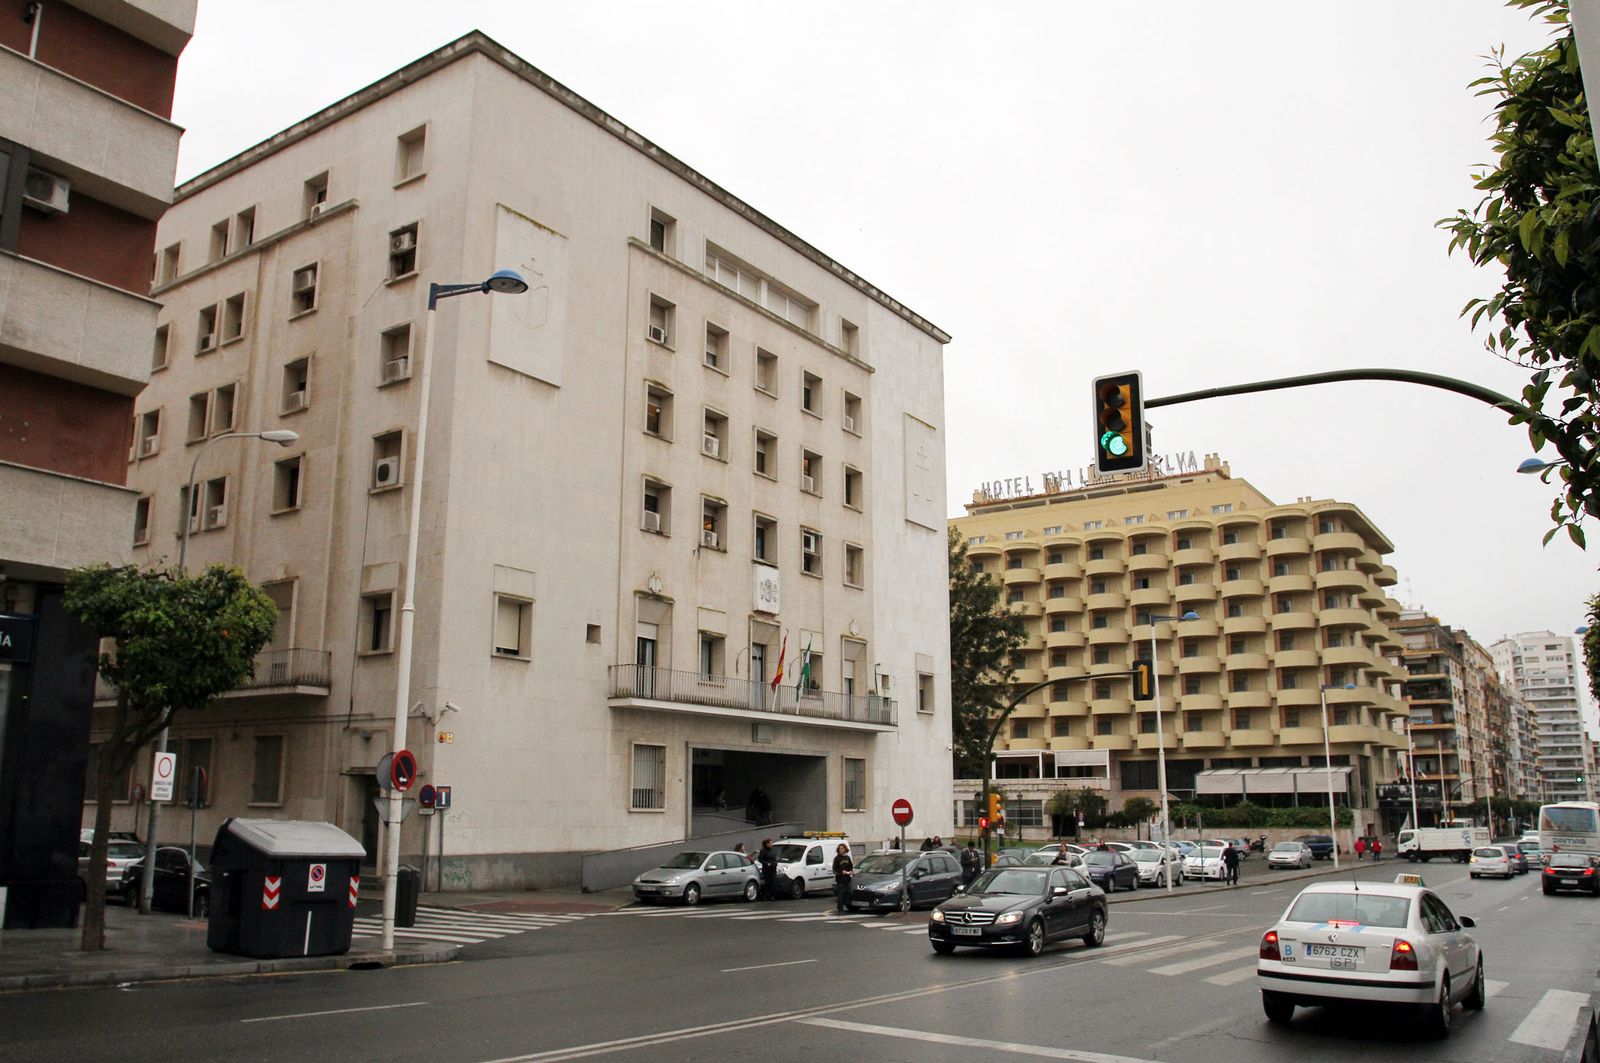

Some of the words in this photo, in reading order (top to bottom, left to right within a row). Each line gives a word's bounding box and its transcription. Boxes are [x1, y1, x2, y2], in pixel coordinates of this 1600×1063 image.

[981, 476, 1034, 497] HOTEL
[1313, 946, 1336, 956] 6762
[1340, 948, 1359, 958] CZX
